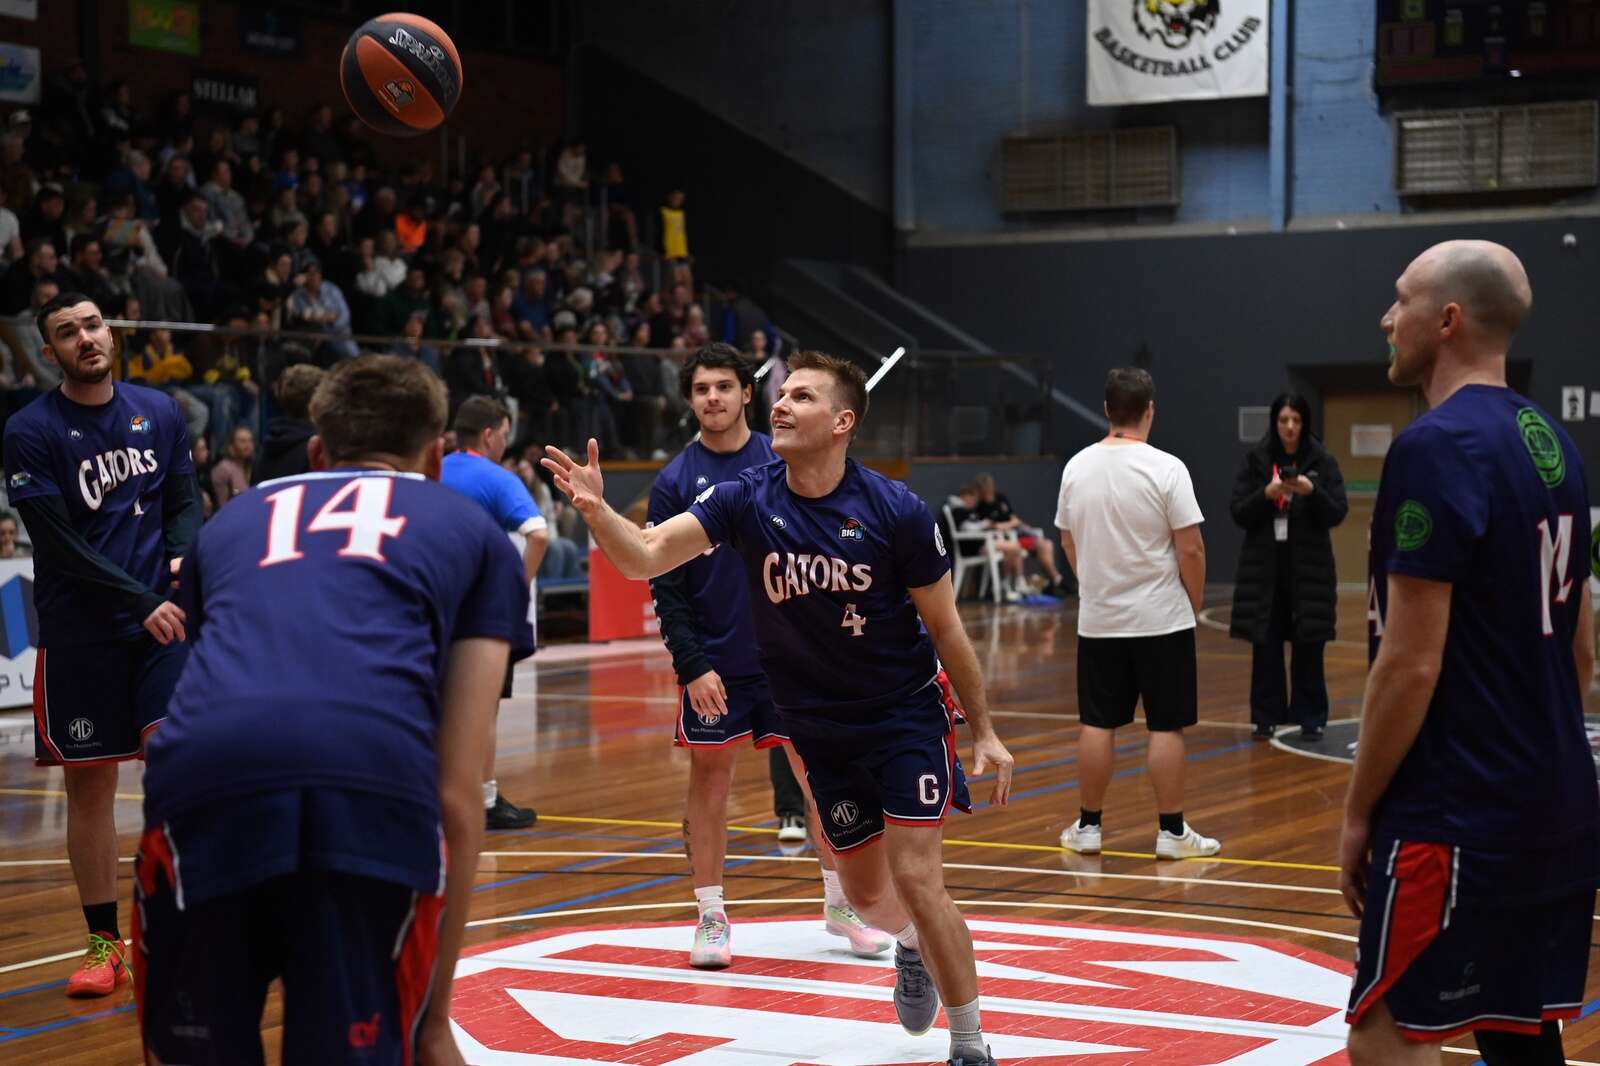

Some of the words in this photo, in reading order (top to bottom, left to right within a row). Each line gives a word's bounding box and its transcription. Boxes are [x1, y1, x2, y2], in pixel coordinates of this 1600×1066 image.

[1094, 27, 1213, 76] BASKETBALL
[1214, 16, 1261, 61] CLUB
[79, 447, 158, 511] GATORS
[258, 476, 408, 568] 14
[841, 529, 855, 537] BIG
[763, 551, 873, 604] GATORS
[840, 603, 867, 636] 4
[70, 719, 92, 739] MG
[918, 774, 940, 805] G
[833, 802, 857, 825] MG
